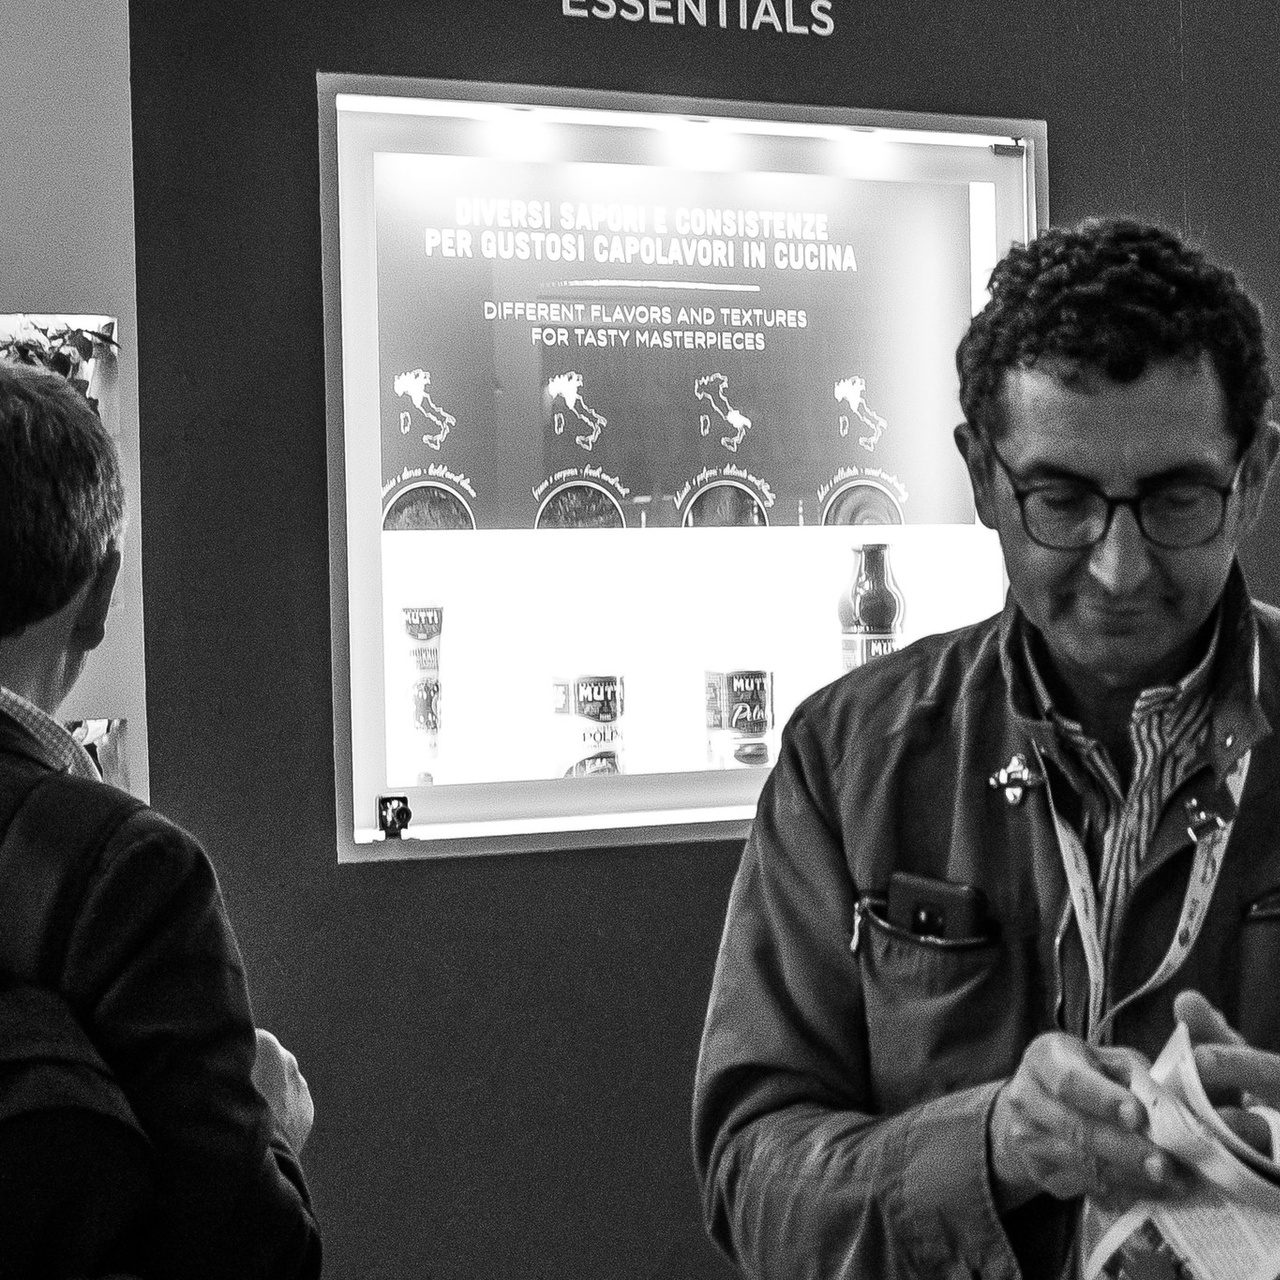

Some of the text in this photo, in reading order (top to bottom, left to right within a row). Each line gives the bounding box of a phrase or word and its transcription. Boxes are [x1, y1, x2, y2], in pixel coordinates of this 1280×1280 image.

[456, 197, 829, 241] DIVERSI SAPORI E CONSISTENZE
[425, 228, 857, 271] PER GUSTOSI CAPOLAVORI IN CUCINA
[484, 301, 808, 328] DIFFERENT FLAVORS AND TEXTURES
[531, 328, 766, 351] FOR TASTY MASTERPIECES
